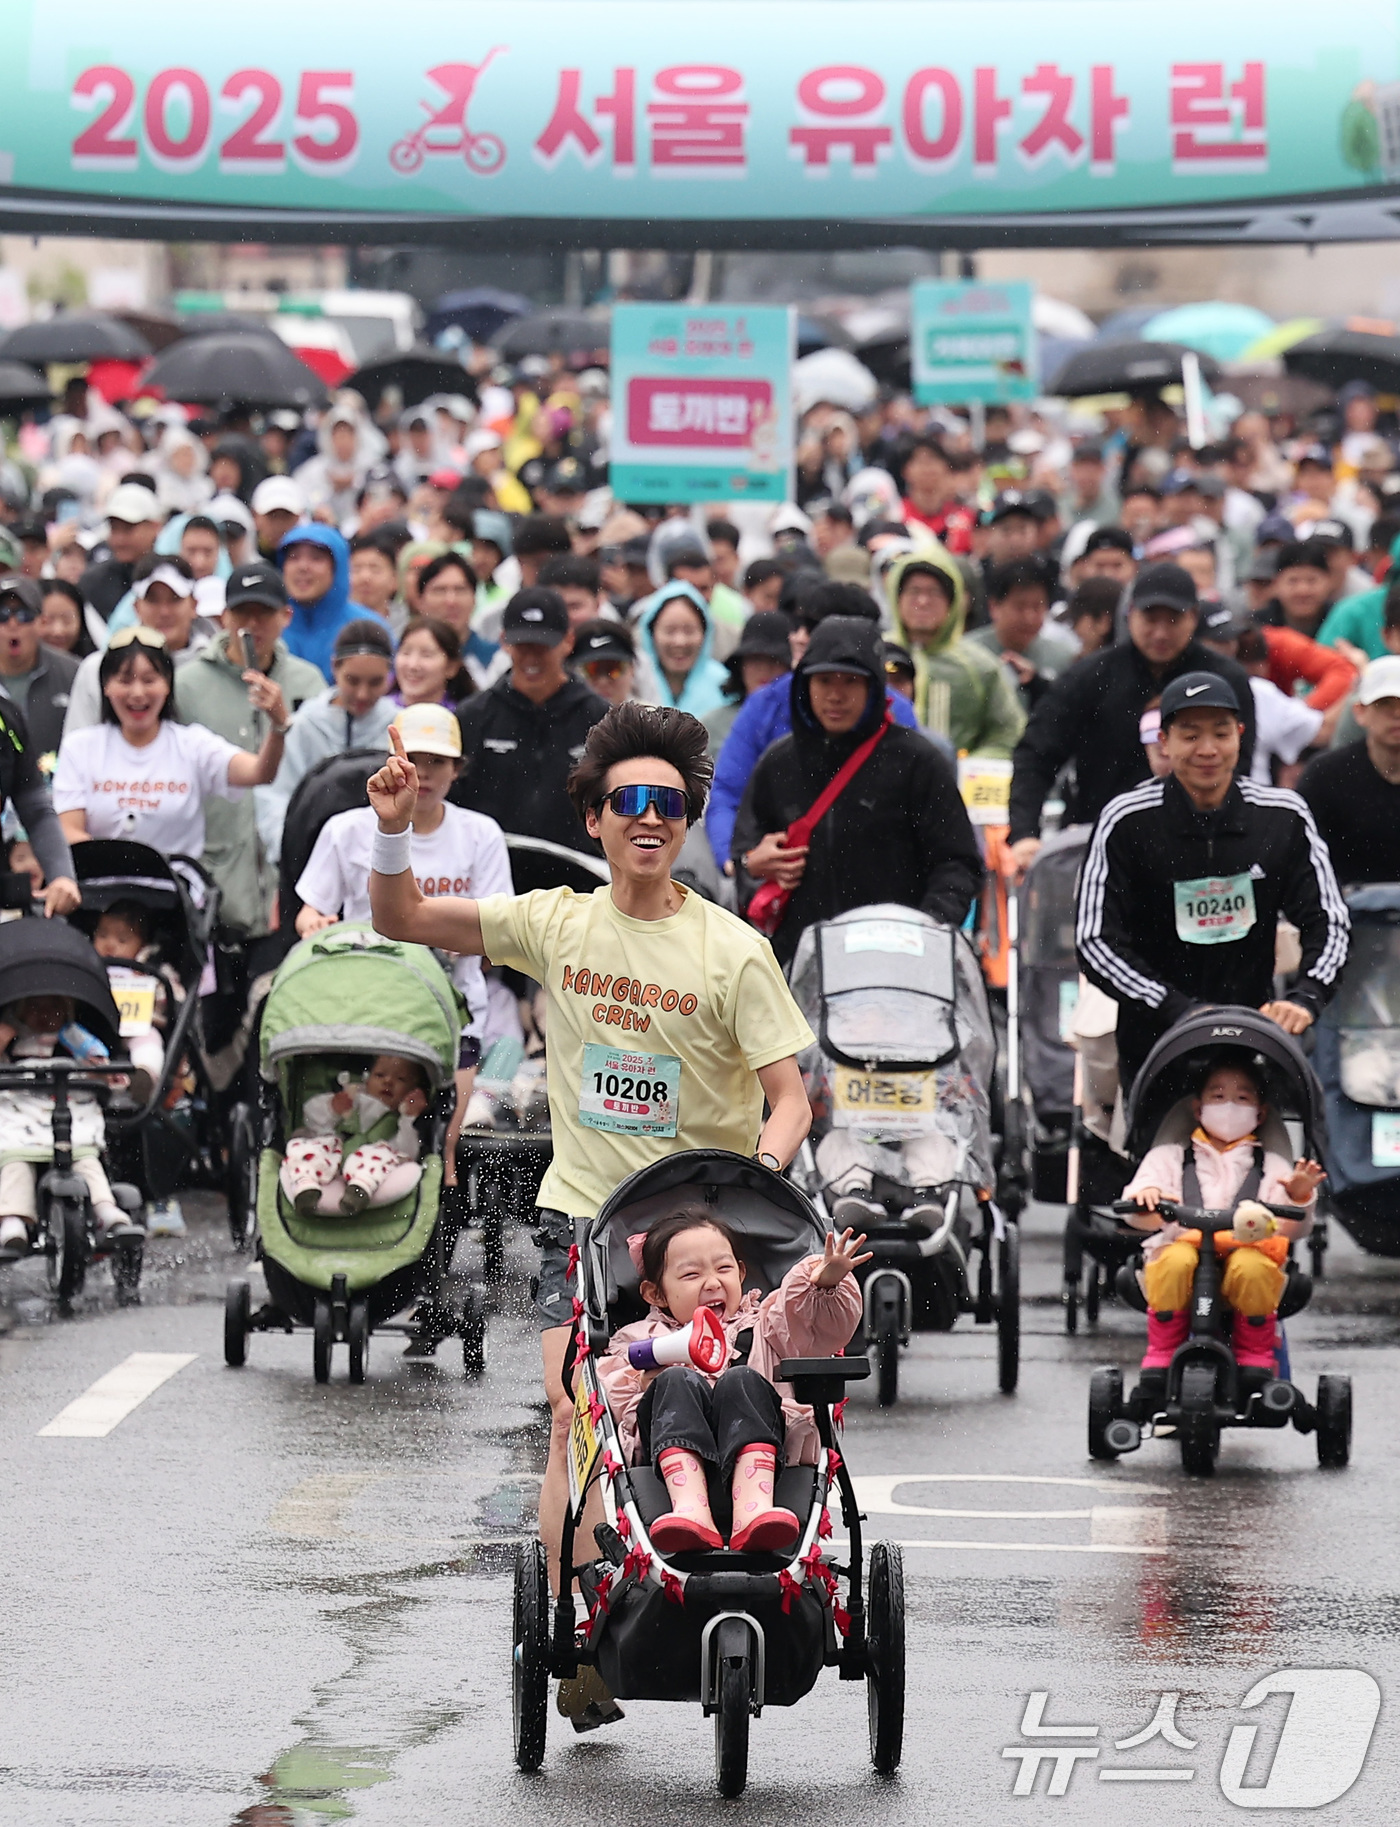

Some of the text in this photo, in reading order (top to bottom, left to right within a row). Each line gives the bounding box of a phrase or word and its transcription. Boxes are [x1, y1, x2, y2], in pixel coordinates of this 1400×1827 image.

[71, 61, 1269, 170] 2025 서울 유아차 런
[1186, 896, 1246, 918] 10240
[562, 965, 698, 1016] KANGAROO
[592, 1003, 652, 1032] CREW
[622, 1054, 644, 1064] 2025
[593, 1072, 668, 1103] 10208
